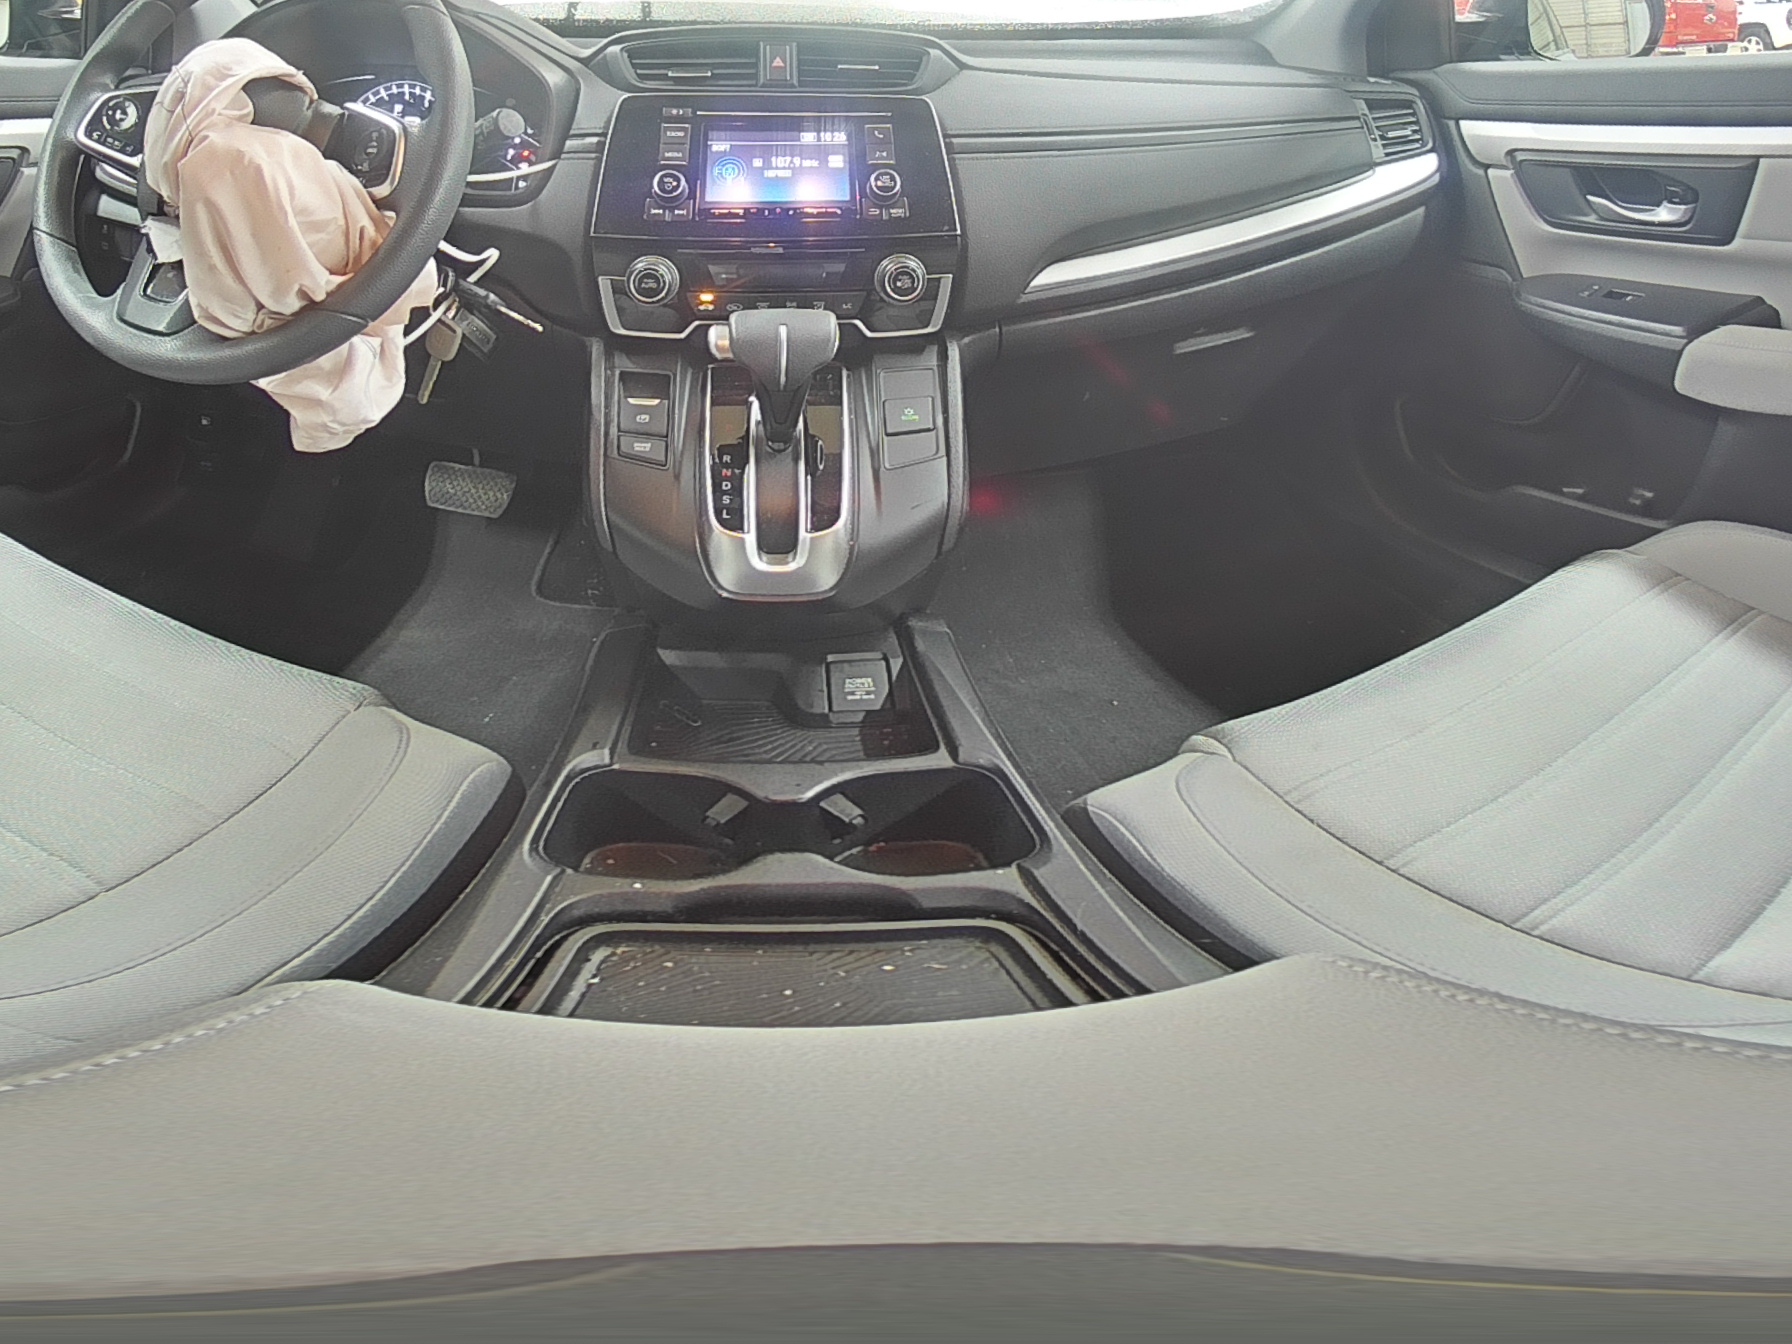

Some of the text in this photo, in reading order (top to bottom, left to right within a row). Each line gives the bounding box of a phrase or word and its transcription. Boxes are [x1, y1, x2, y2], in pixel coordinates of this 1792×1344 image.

[771, 155, 800, 168] 107.9
[722, 455, 731, 463] R
[722, 468, 731, 477] N
[722, 481, 731, 490] D
[722, 495, 730, 504] S
[722, 509, 731, 518] L
